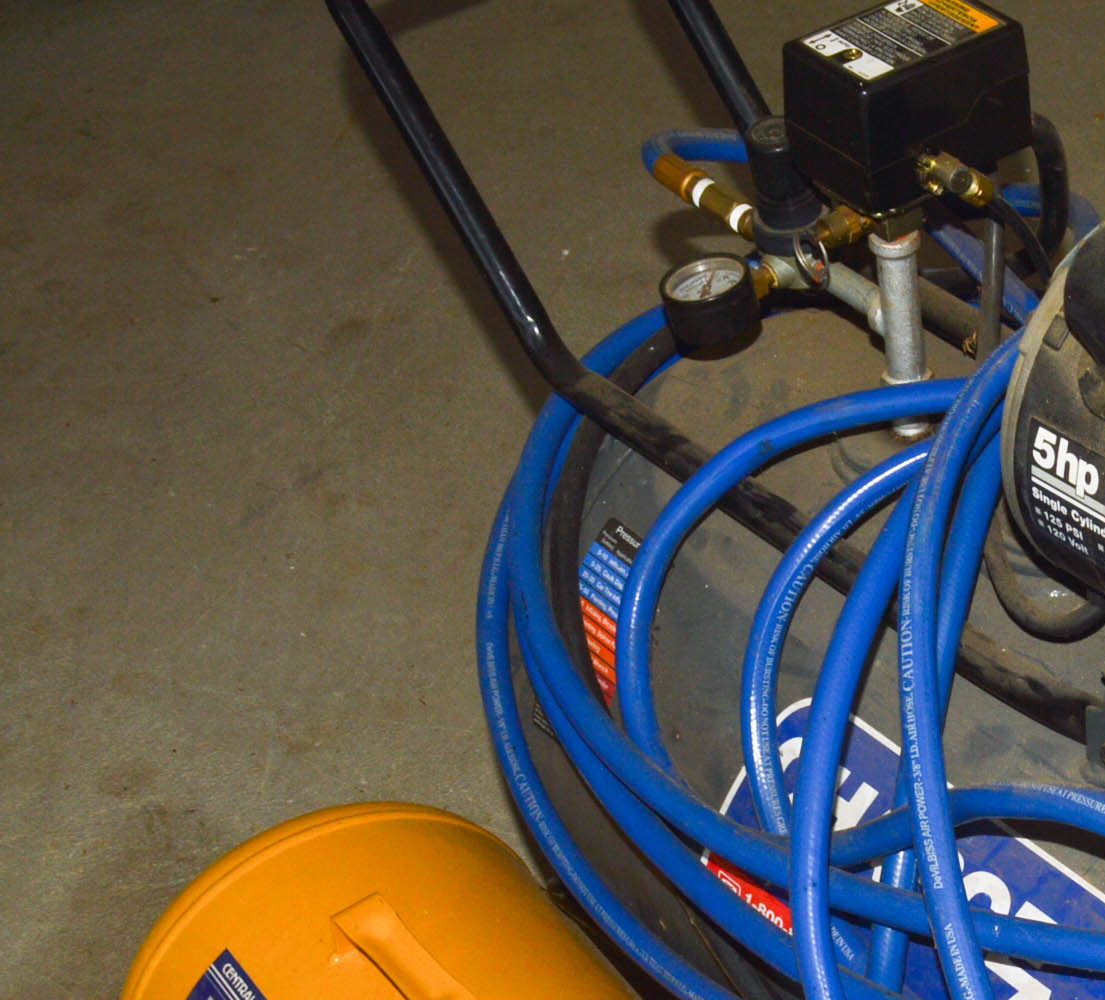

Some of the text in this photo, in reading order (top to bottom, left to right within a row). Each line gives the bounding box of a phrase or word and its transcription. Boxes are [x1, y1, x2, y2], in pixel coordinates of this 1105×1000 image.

[1032, 426, 1099, 498] 5hp
[1033, 485, 1066, 517] Single
[1045, 510, 1082, 540] 125 PSI
[1068, 536, 1087, 555] Volt
[767, 643, 778, 656] OF
[757, 716, 772, 737] NOT
[905, 722, 918, 741] AIR
[920, 819, 932, 837] AIR
[924, 836, 944, 889] DeVILBISS
[941, 922, 958, 944] USA
